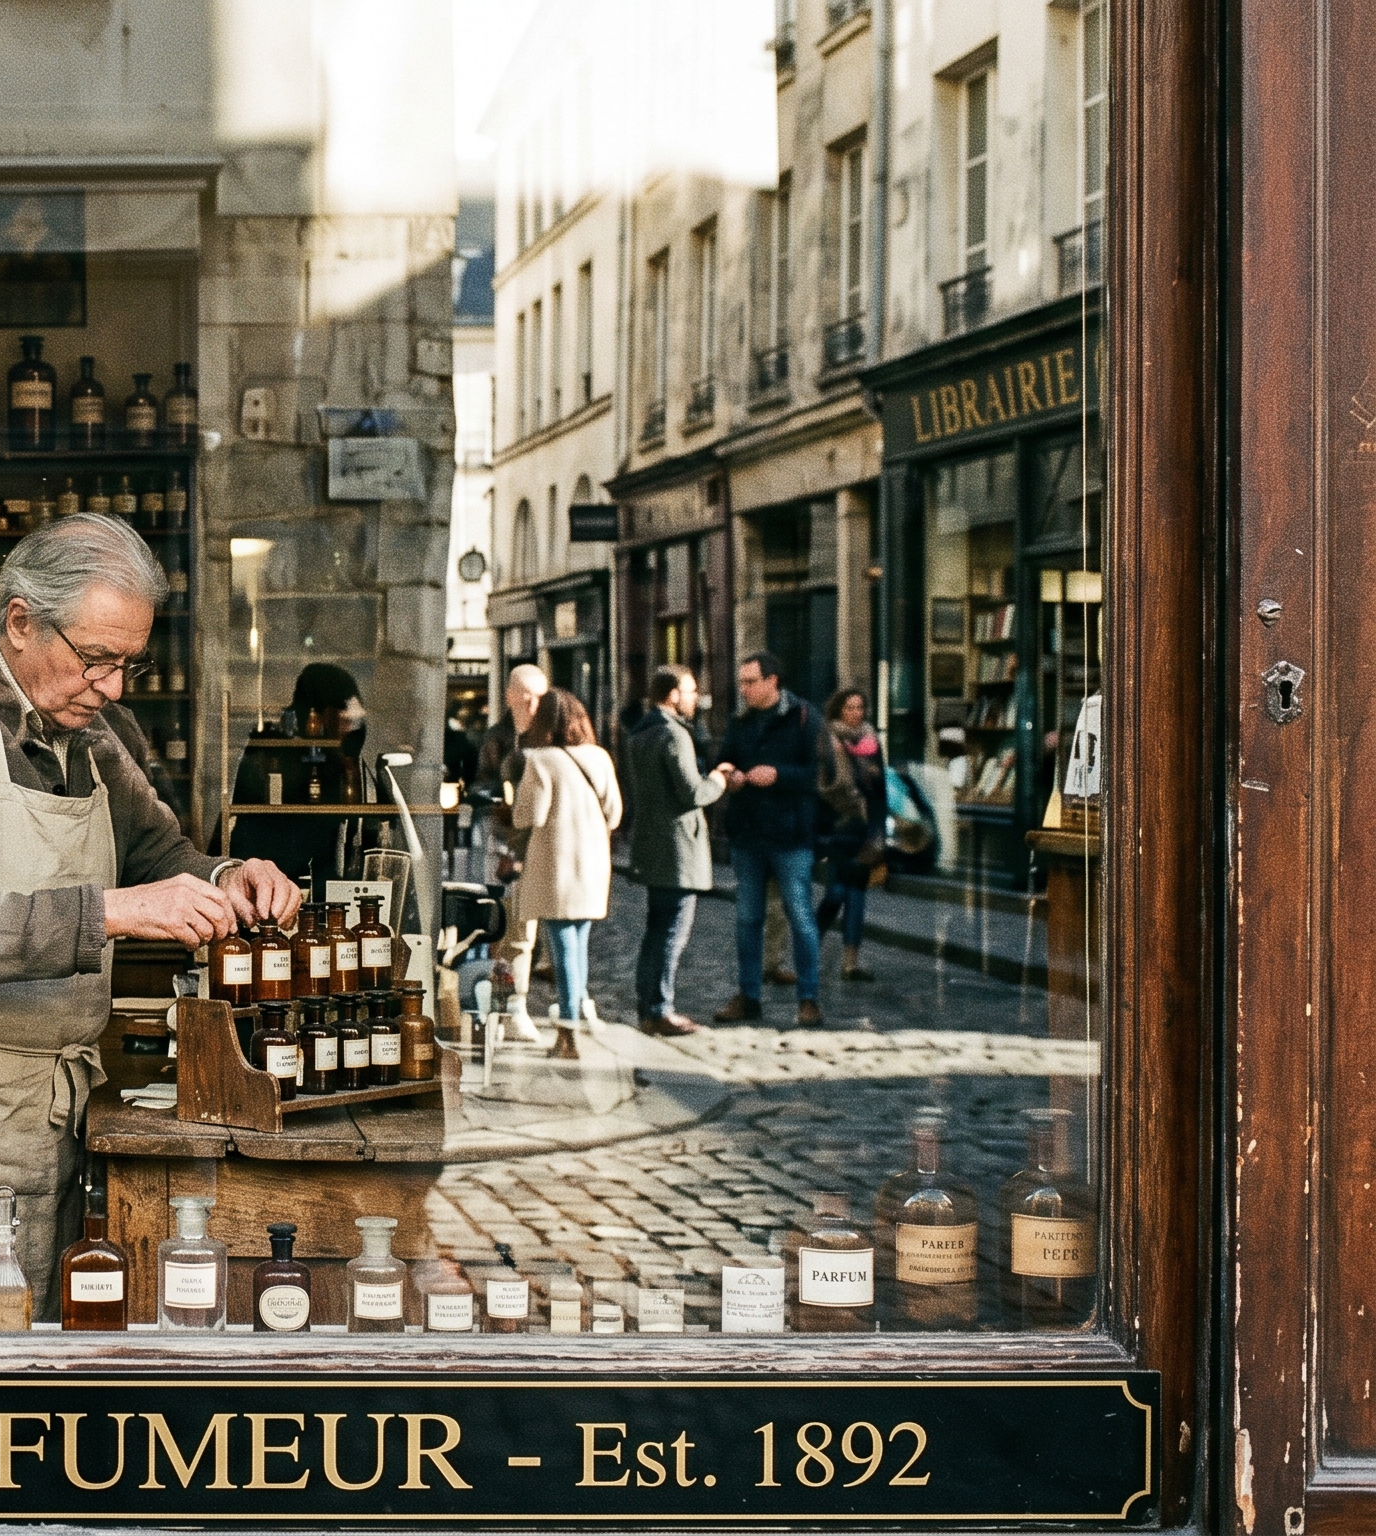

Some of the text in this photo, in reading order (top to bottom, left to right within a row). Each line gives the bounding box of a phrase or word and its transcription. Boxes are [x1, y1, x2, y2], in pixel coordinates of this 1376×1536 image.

[910, 348, 1080, 443] LIBRAIRIE
[812, 1270, 867, 1283] PARFUM
[575, 1421, 718, 1488] Est.
[754, 1420, 932, 1489] 1892
